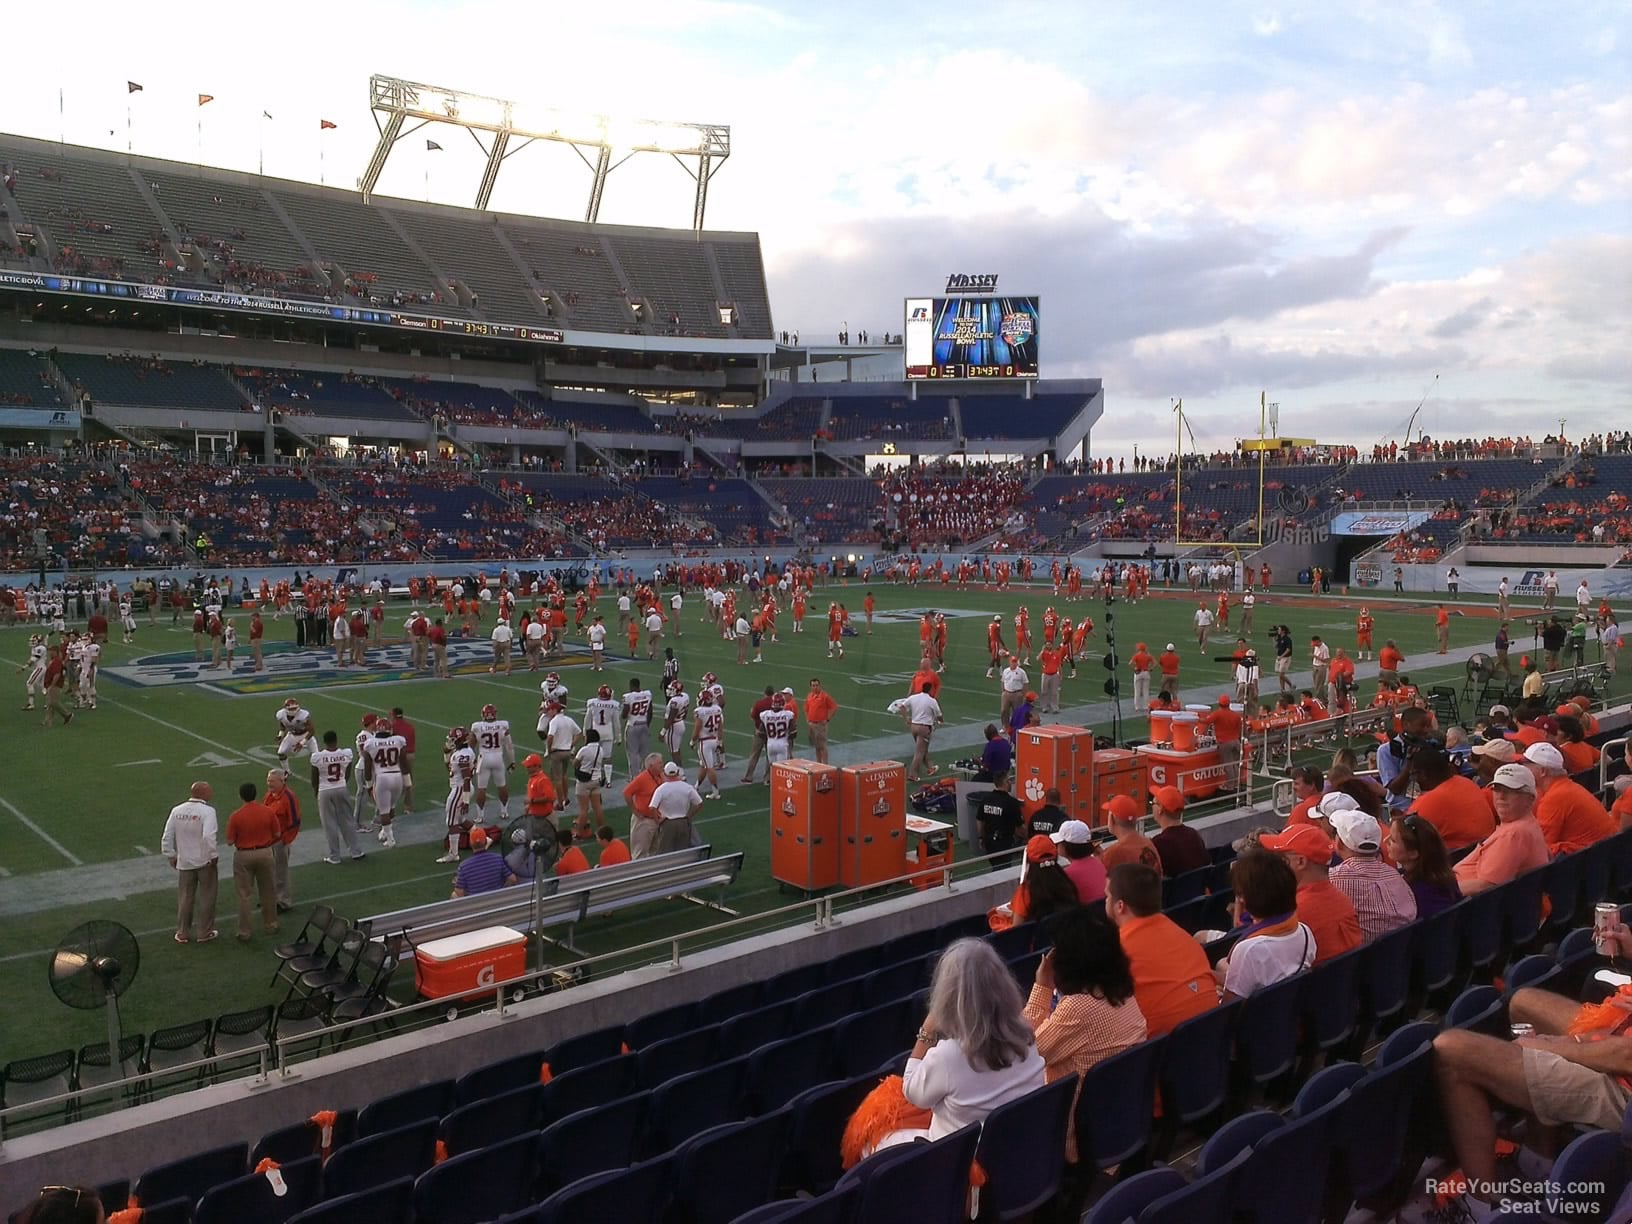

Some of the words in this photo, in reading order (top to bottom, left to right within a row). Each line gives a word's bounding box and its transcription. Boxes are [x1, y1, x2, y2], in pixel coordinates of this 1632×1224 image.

[22, 277, 45, 286] BOWL
[947, 273, 998, 287] MASSEY
[187, 294, 220, 304] WELCOME
[243, 300, 259, 308] 2014
[259, 302, 283, 311] RUSSELL
[284, 304, 312, 314] ATHLETIC
[312, 307, 331, 315] BOWL
[400, 318, 427, 328] Clemson
[431, 319, 438, 329] 0
[465, 324, 488, 335] 37:43
[520, 328, 527, 338] 0
[956, 326, 977, 334] 2014
[531, 332, 560, 342] Oklahoma
[962, 332, 994, 340] ATHLETIC
[930, 367, 937, 376] 0
[1006, 366, 1012, 376] 0
[631, 700, 648, 716] 85
[599, 709, 606, 726] 1
[766, 721, 786, 739] 82
[481, 731, 500, 749] 31
[374, 749, 399, 768] 40
[327, 763, 341, 782] 9
[865, 770, 899, 783] CLEMSON
[1151, 766, 1166, 784] G
[1193, 765, 1226, 781] GATOR
[984, 804, 1003, 816] SECURITY
[1033, 821, 1054, 832] SECURITY
[476, 964, 495, 987] G
